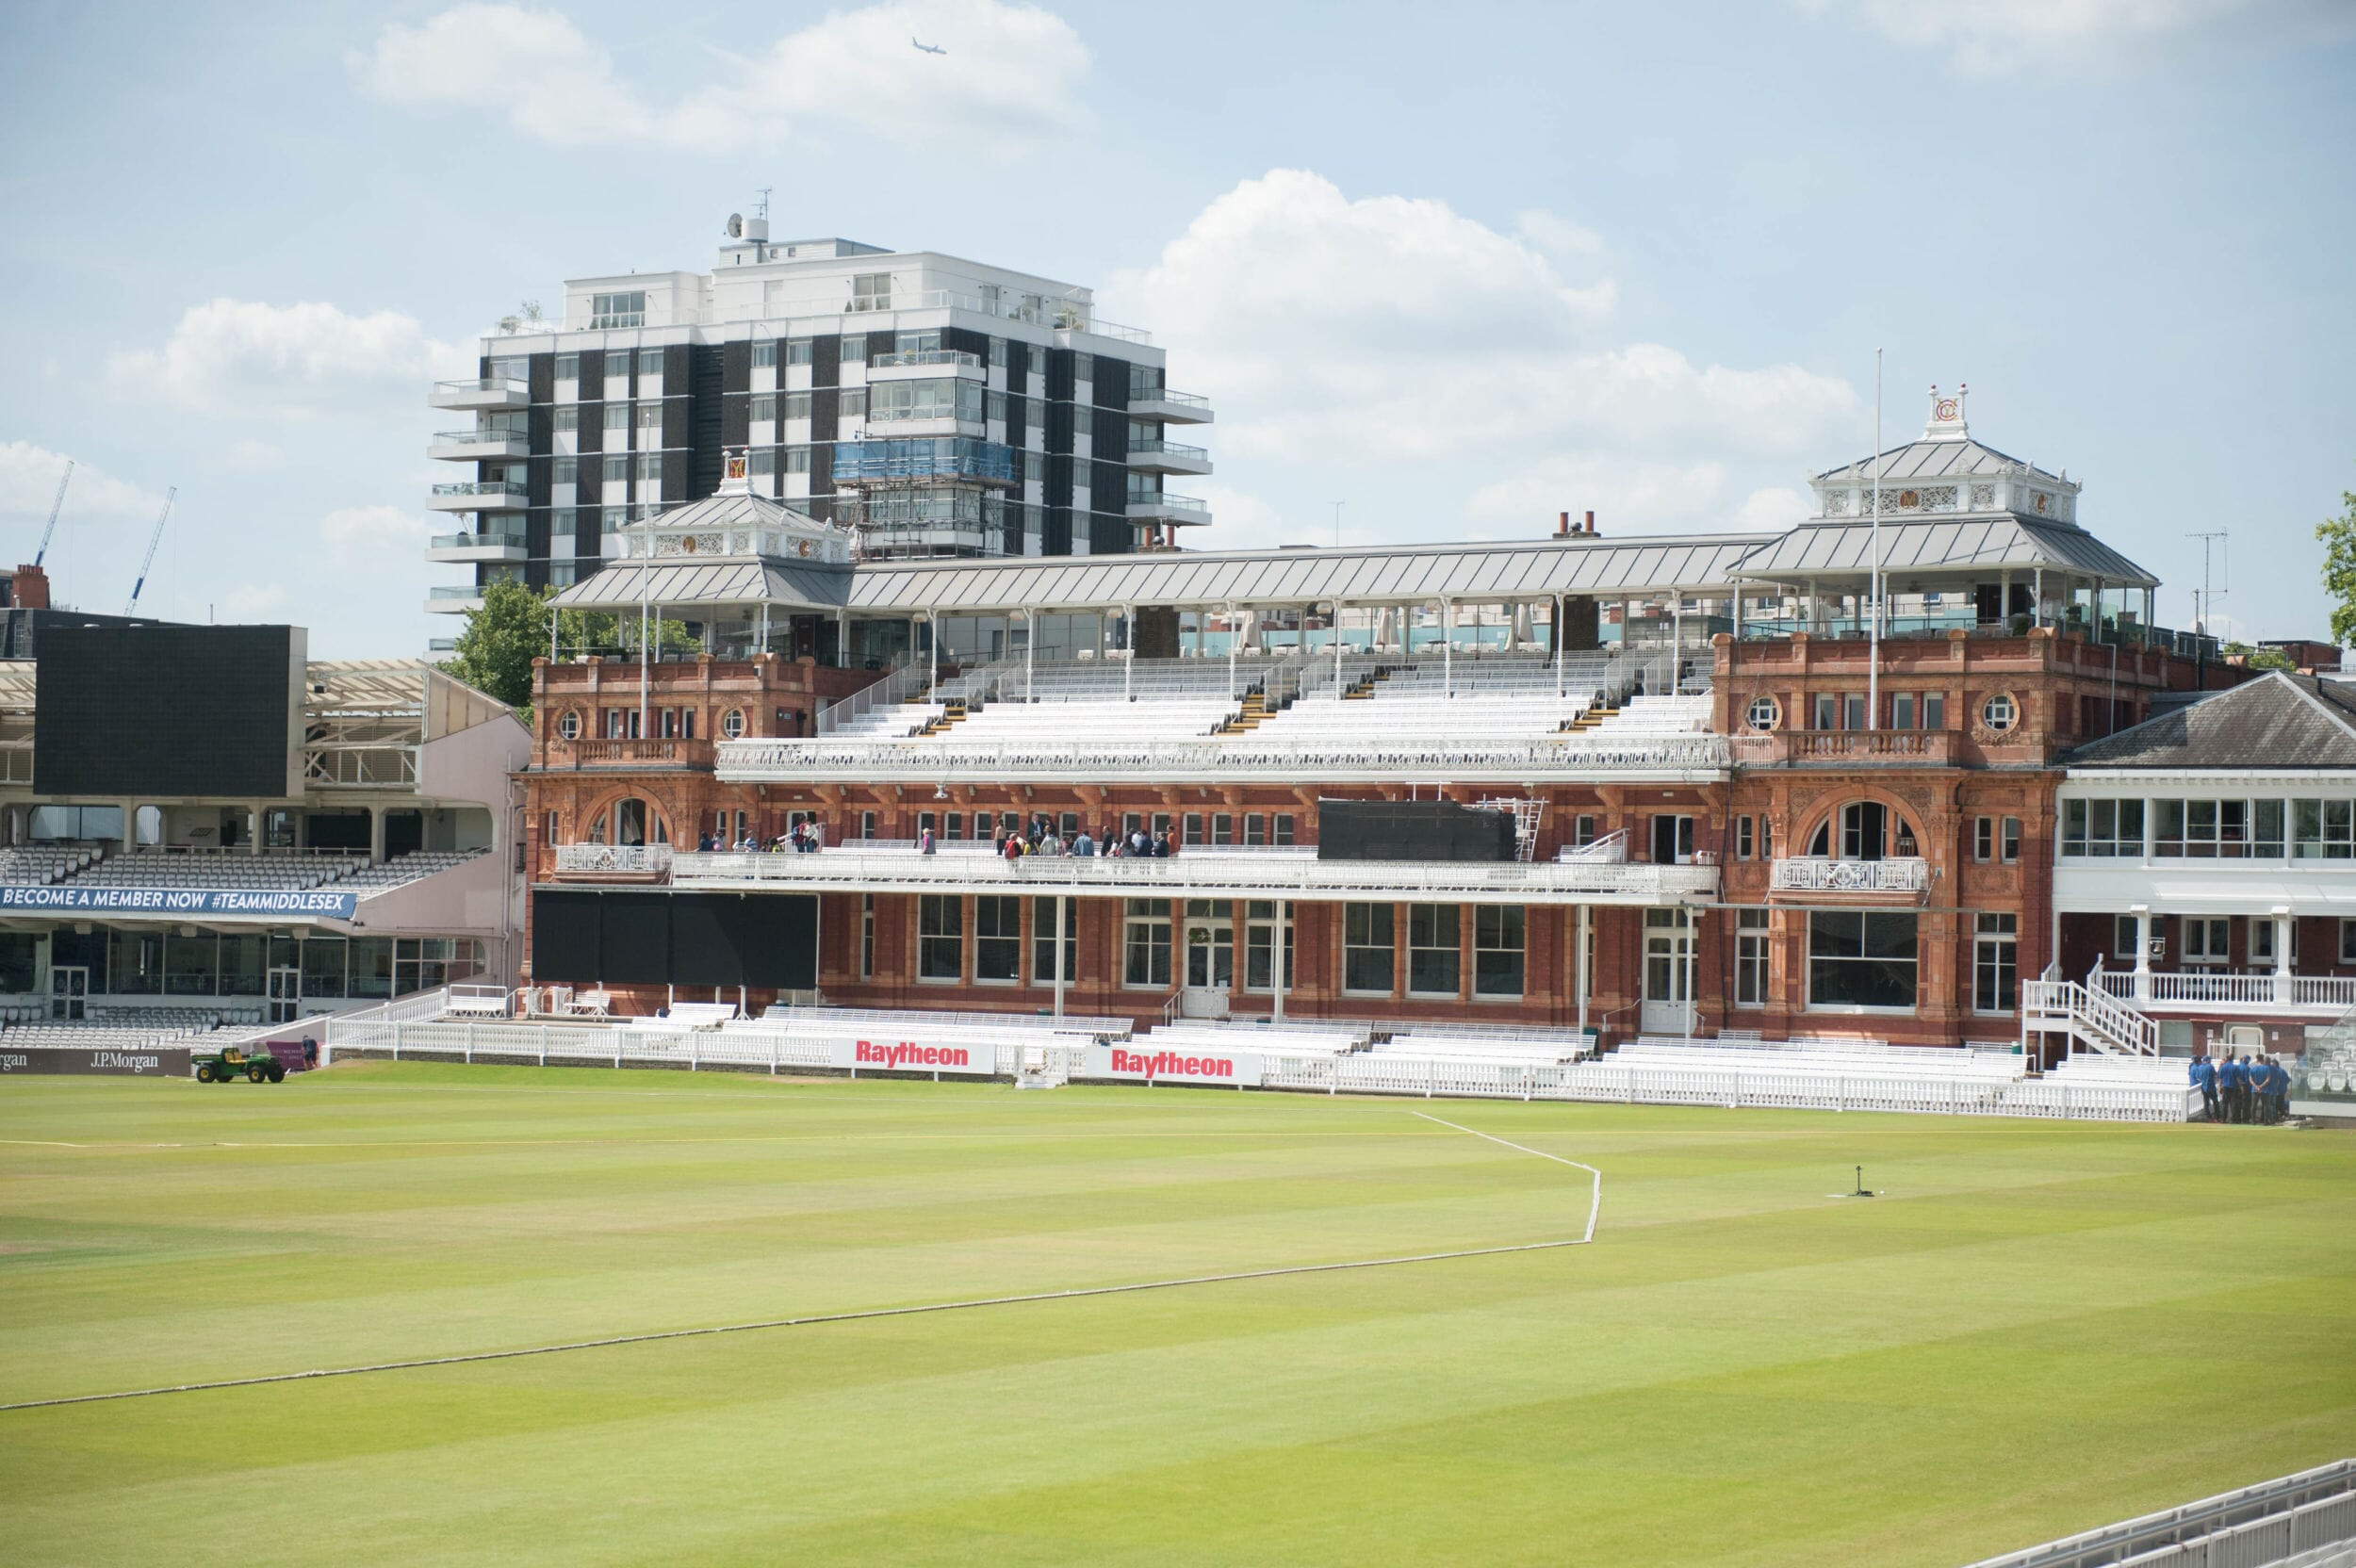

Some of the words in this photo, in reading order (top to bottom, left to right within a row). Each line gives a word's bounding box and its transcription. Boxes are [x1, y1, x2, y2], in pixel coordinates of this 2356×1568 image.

[3, 889, 75, 905] BECOME
[77, 890, 90, 906] A
[92, 890, 164, 907] MEMBER
[165, 892, 206, 908] NOW
[211, 893, 344, 910] #TEAMMIDDLESEX
[90, 1052, 159, 1073] J.P.Morgan
[856, 1040, 969, 1069] Raytheon
[1111, 1049, 1234, 1079] Raytheon
